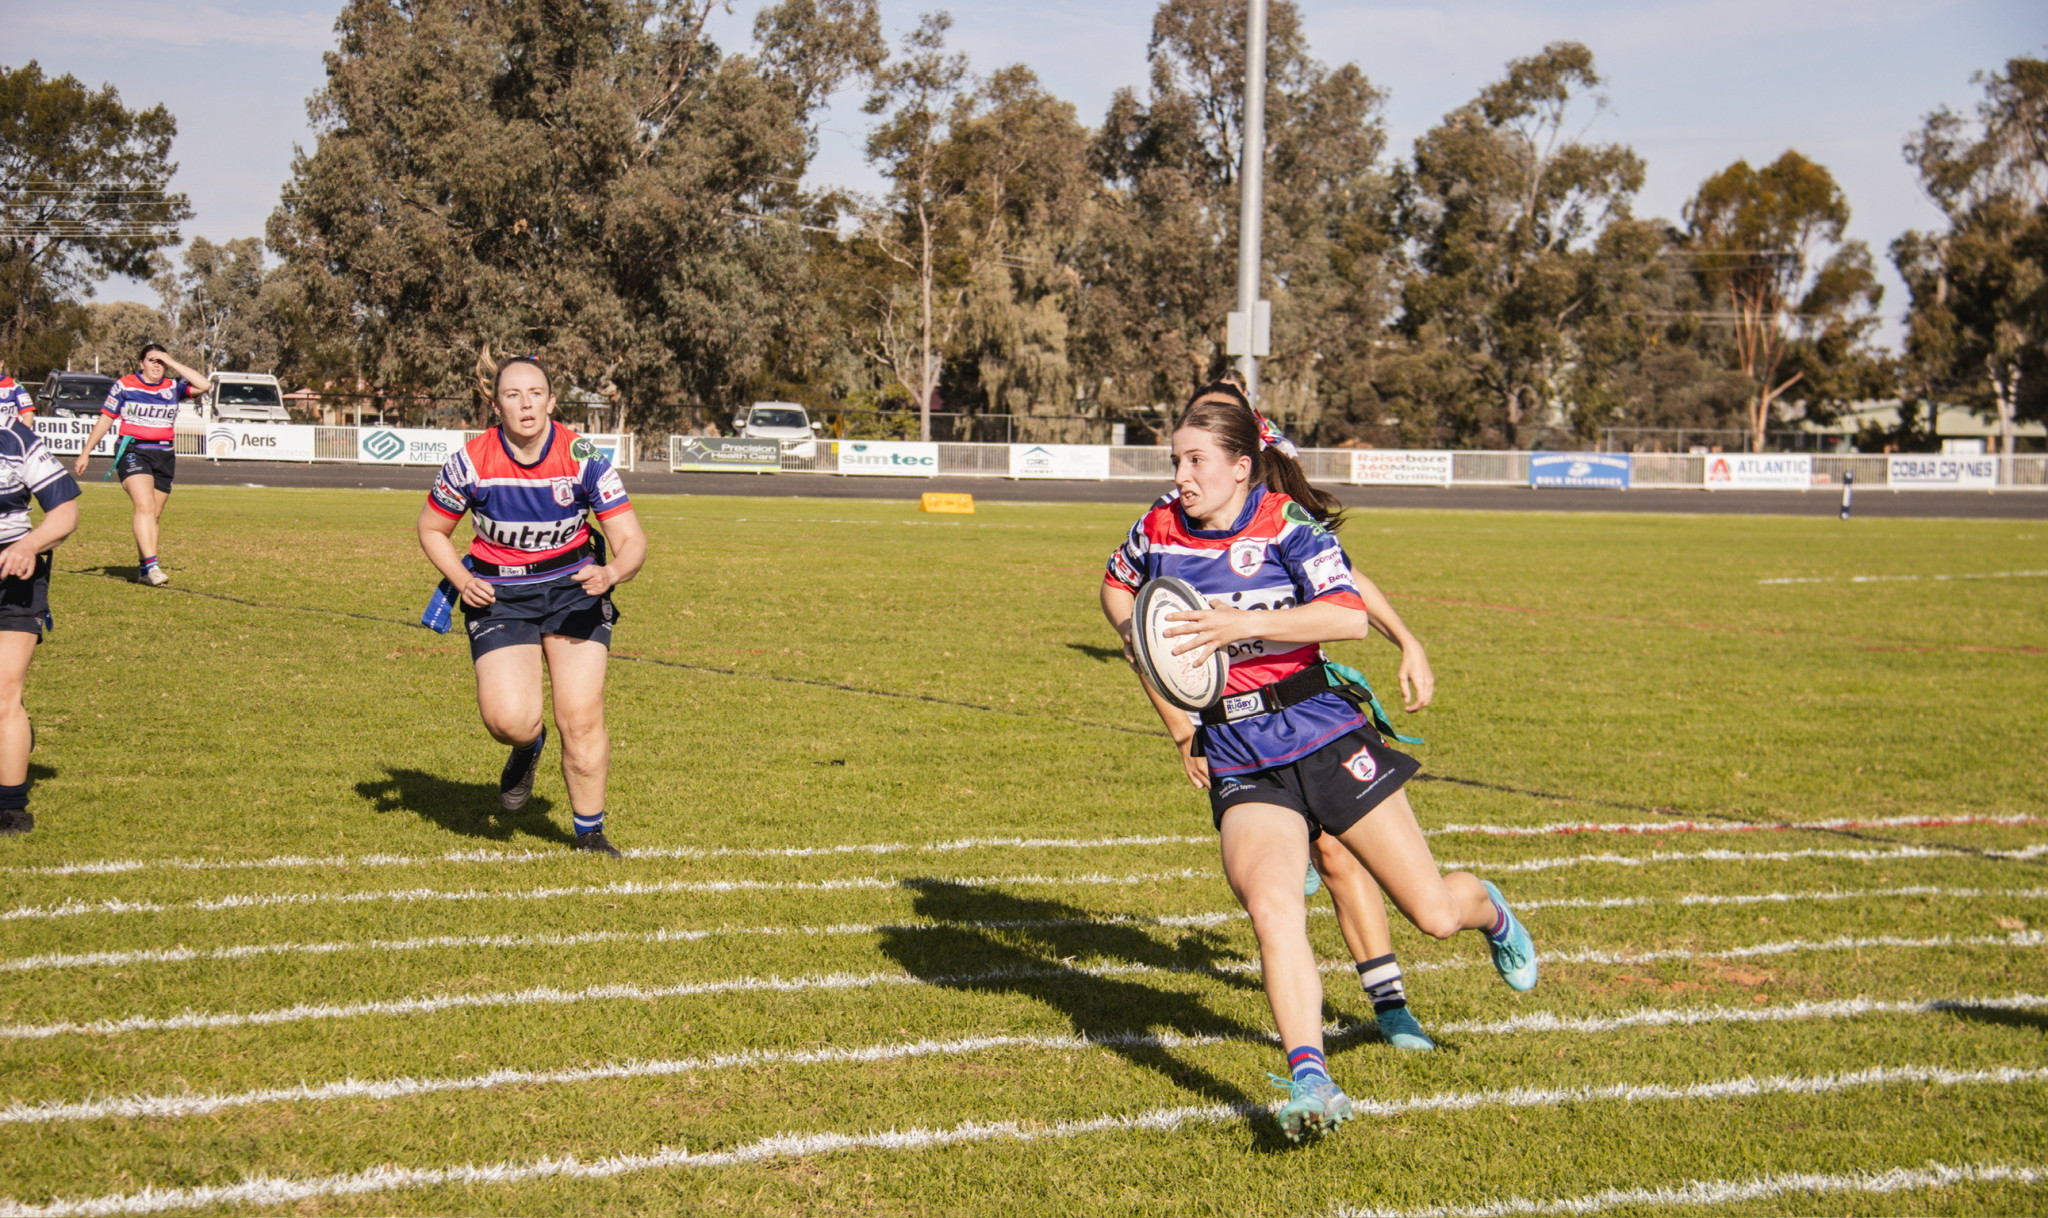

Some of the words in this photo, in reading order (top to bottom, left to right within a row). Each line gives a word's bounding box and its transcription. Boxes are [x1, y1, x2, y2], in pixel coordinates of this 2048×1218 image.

[241, 433, 276, 447] Aeris
[410, 441, 447, 452] SIMS
[721, 443, 777, 453] Precision
[409, 452, 451, 462] META
[711, 452, 748, 460] Health
[749, 452, 777, 460] Care
[842, 453, 934, 466] simtec
[1738, 460, 1807, 473] ATLANTIC
[1891, 461, 1936, 477] COBAR
[1226, 699, 1251, 710] RUGBY
